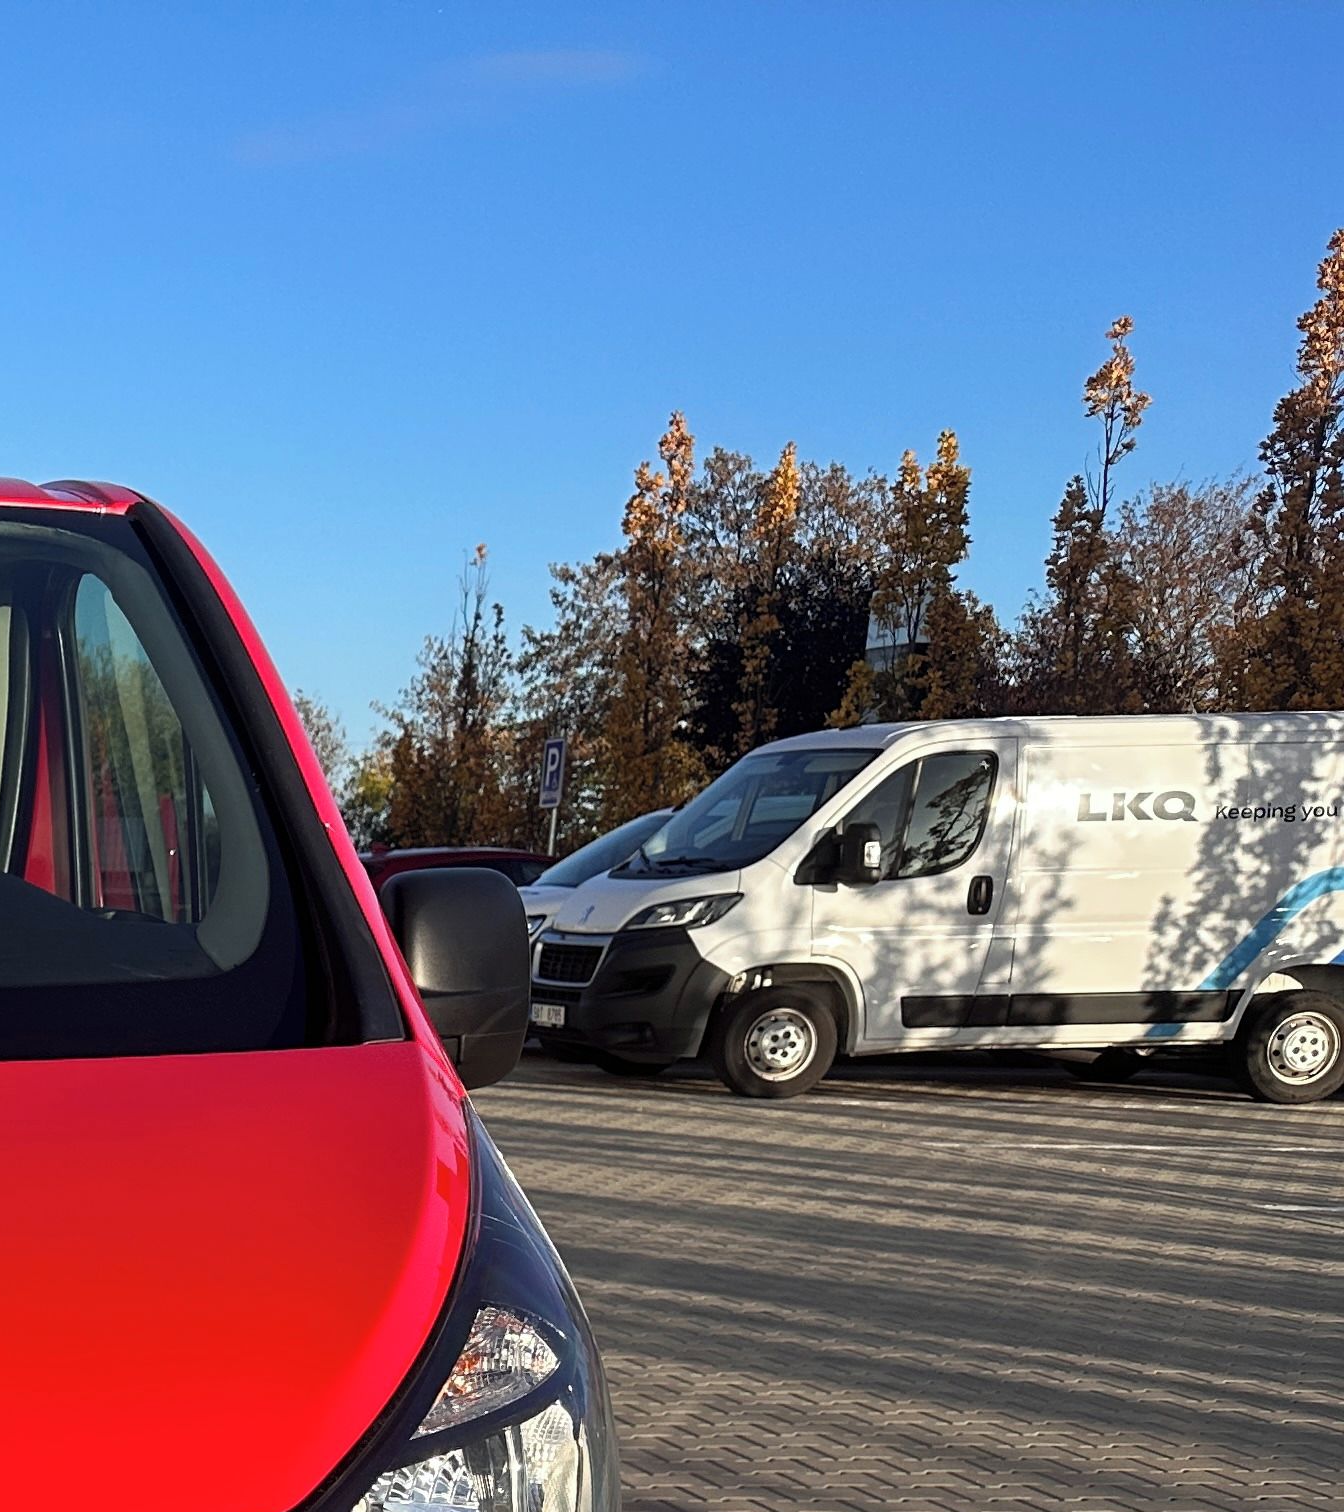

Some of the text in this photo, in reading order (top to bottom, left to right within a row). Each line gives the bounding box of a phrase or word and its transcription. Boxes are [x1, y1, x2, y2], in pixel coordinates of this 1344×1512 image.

[545, 748, 559, 787] P
[1077, 791, 1199, 822] LKQ
[1215, 803, 1338, 822] Keeping you
